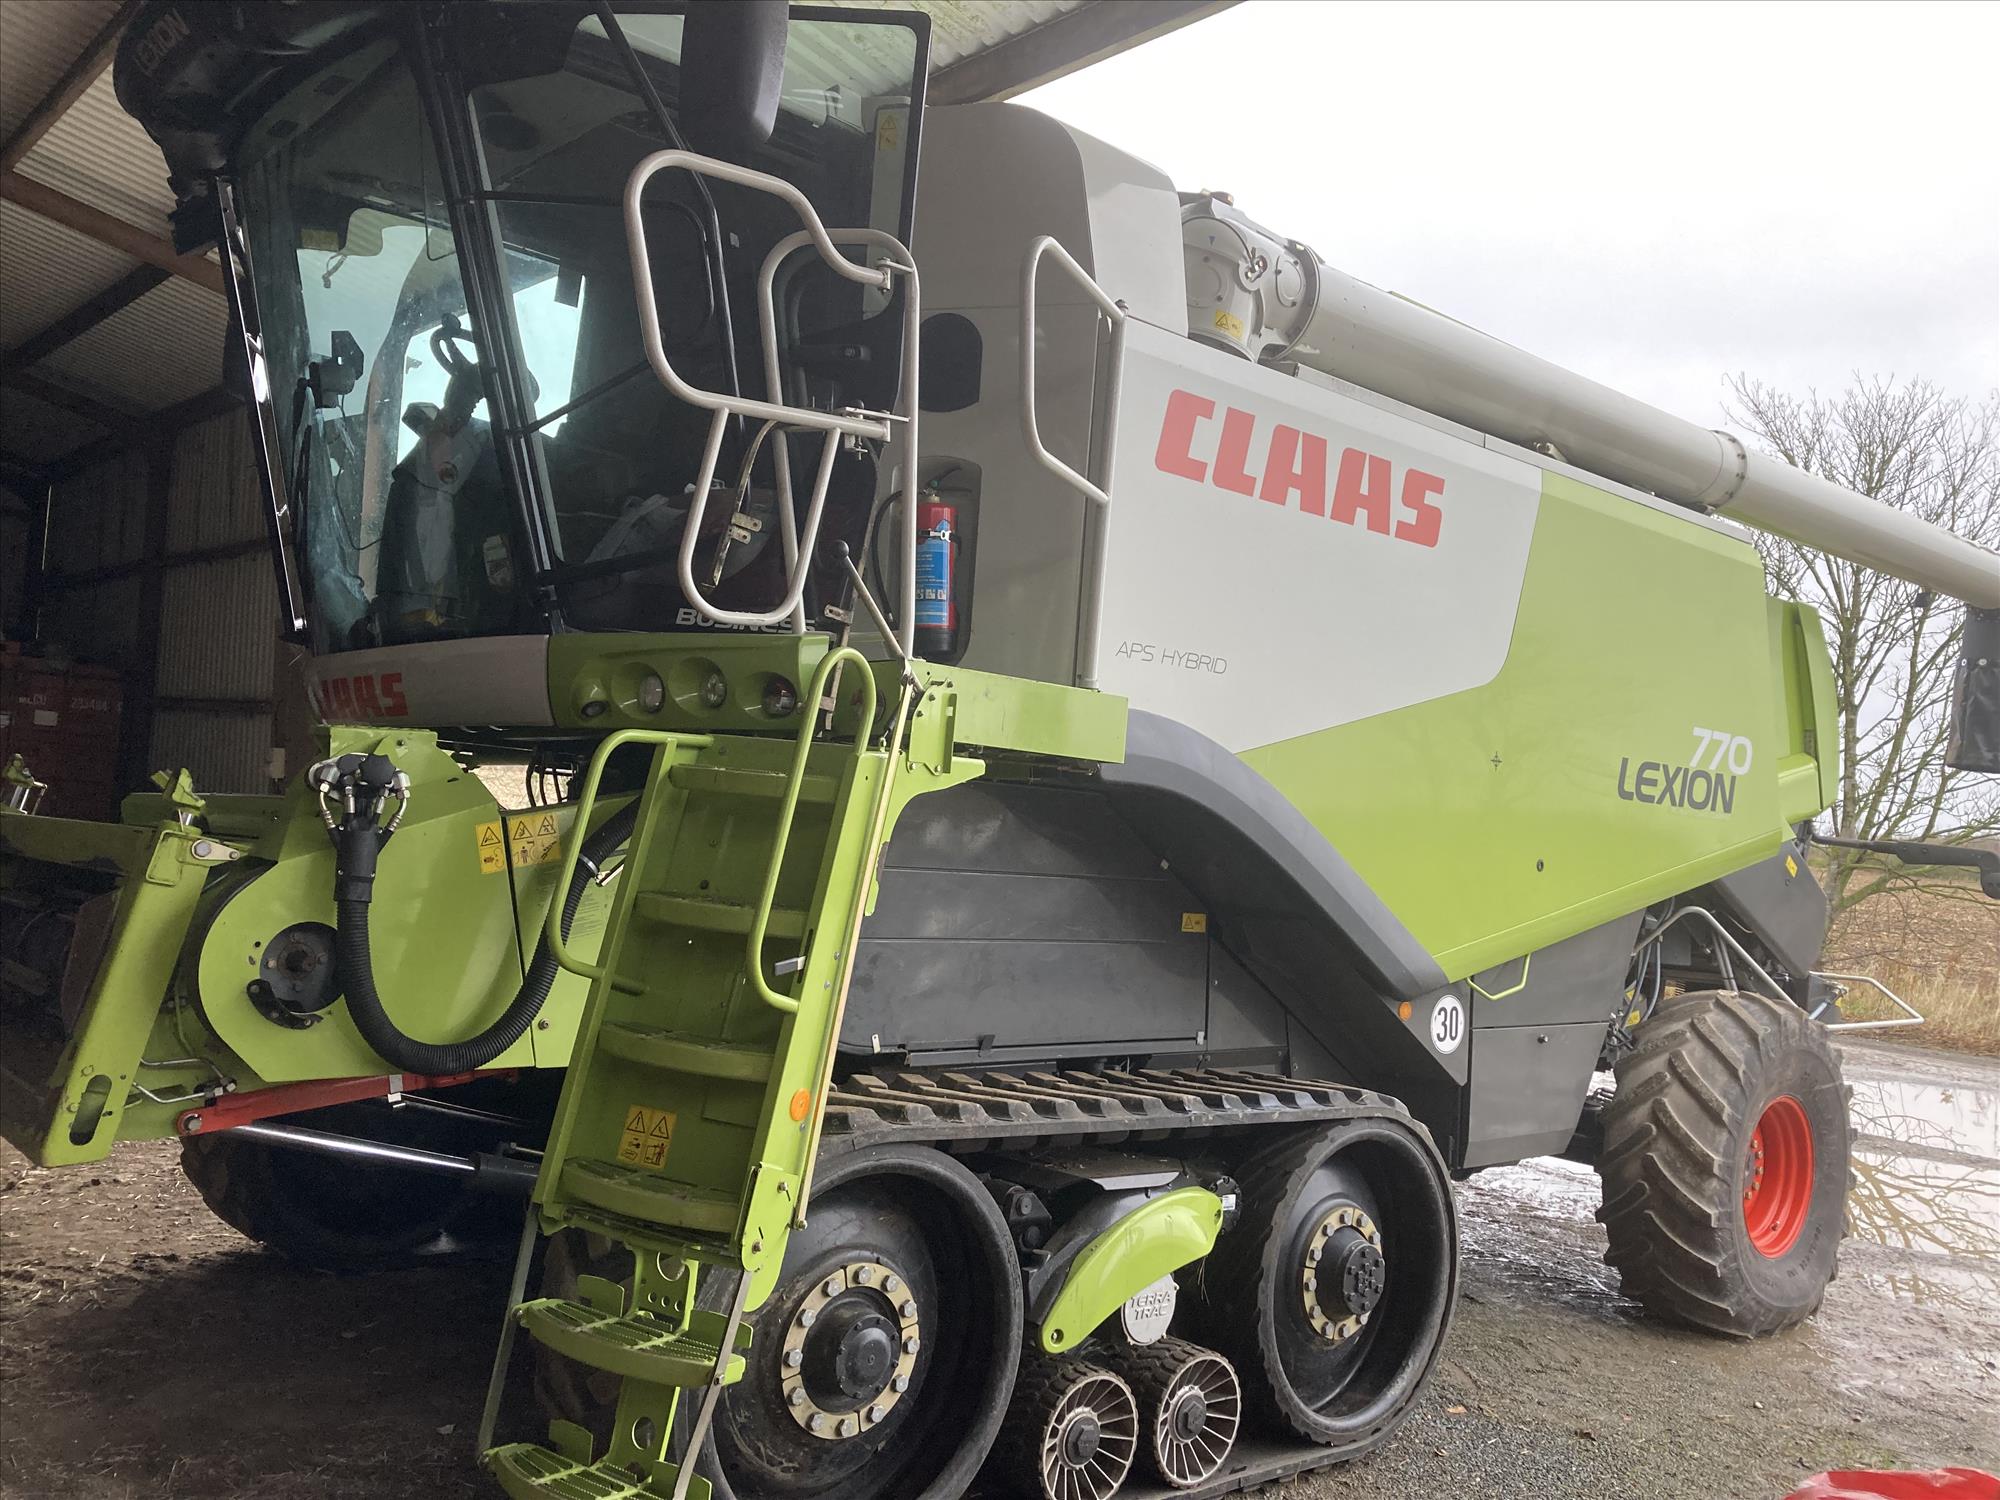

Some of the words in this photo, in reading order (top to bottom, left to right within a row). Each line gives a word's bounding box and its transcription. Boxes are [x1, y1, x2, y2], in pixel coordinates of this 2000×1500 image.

[1155, 388, 1446, 549] CLAAS
[1115, 641, 1156, 662] APS
[1161, 648, 1228, 675] HYBRID
[319, 672, 407, 720] LAAS
[1690, 727, 1753, 775] 770
[1617, 757, 1737, 814] LEXION
[1436, 1006, 1459, 1042] 30
[1131, 1292, 1171, 1308] TERRA
[1135, 1305, 1168, 1320] TRAC
